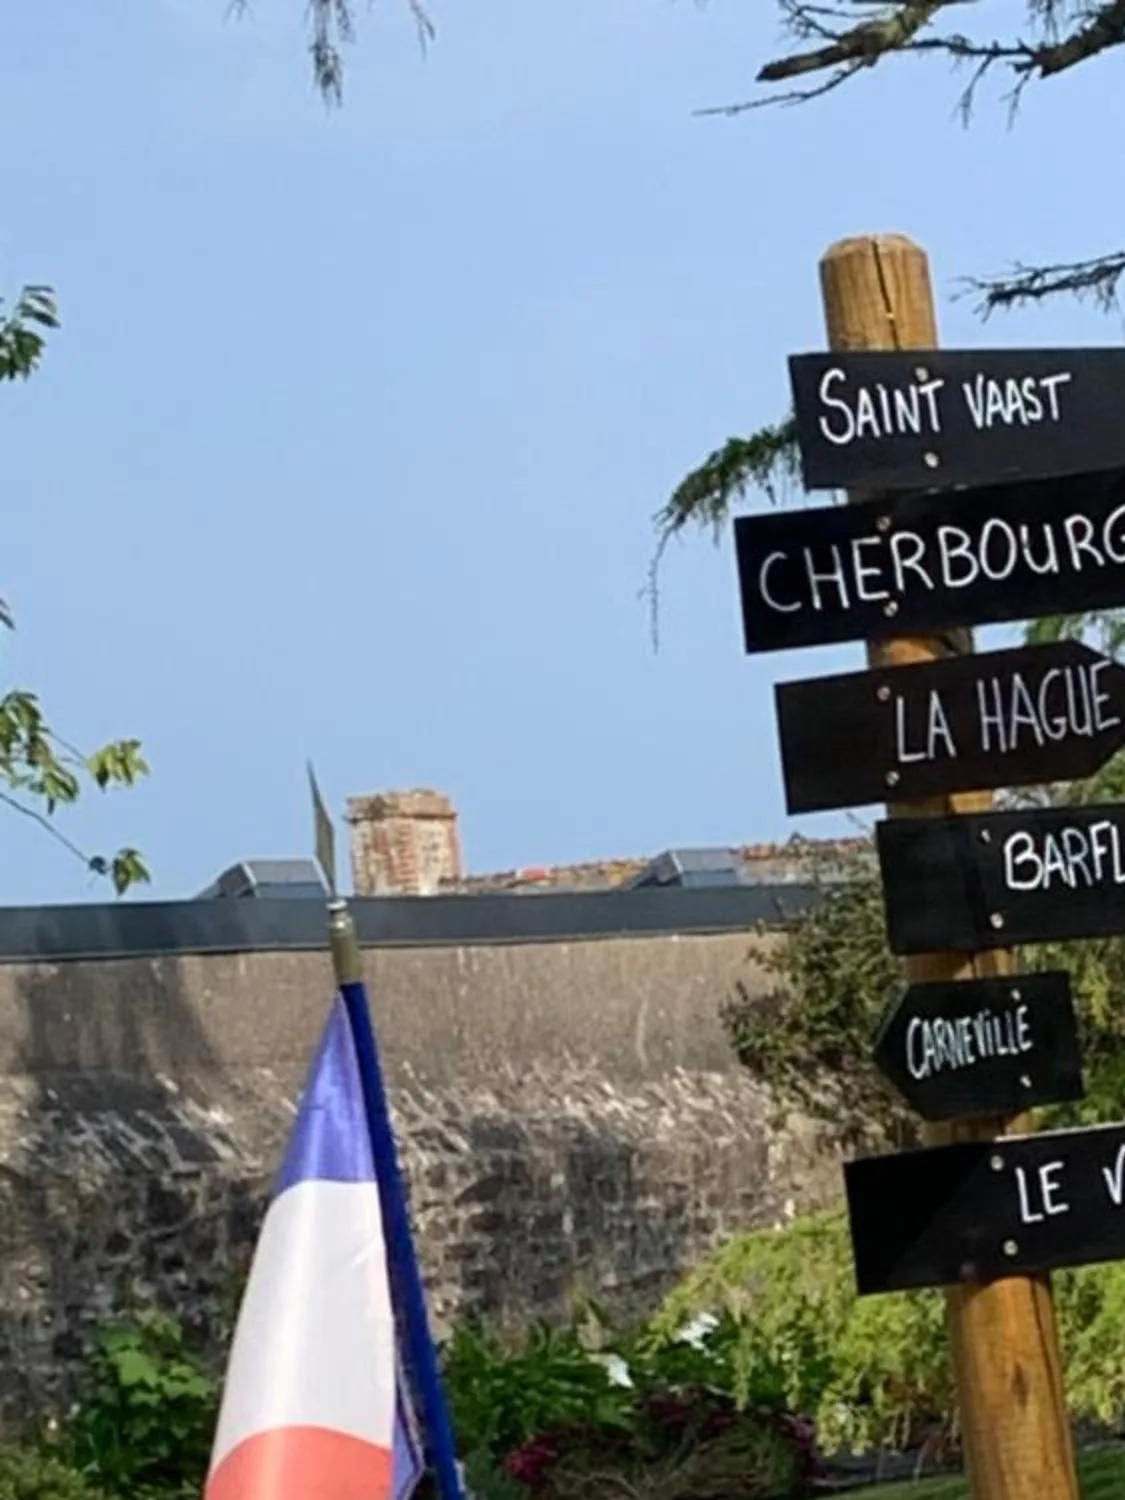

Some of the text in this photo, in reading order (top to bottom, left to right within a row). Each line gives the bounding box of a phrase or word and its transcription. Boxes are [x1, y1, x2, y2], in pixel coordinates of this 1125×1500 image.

[819, 367, 1072, 445] SAINT VAAST
[896, 660, 1122, 763] LA HAGUE
[1015, 1161, 1069, 1223] LE
